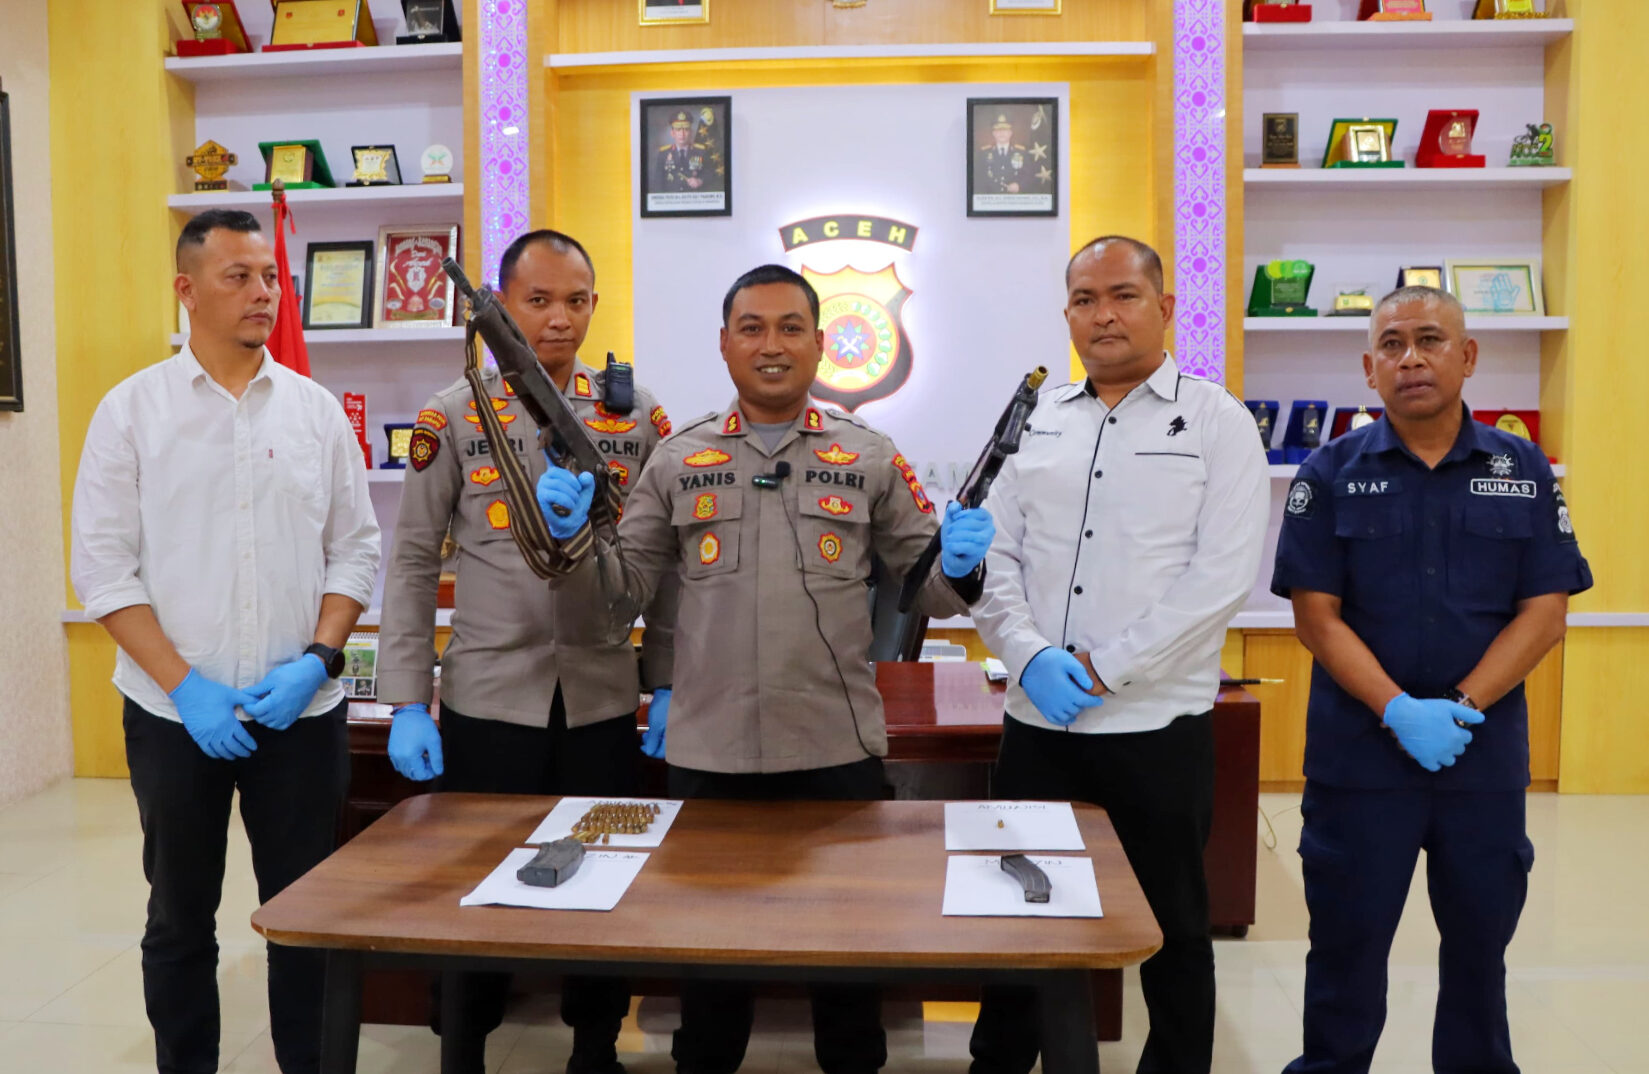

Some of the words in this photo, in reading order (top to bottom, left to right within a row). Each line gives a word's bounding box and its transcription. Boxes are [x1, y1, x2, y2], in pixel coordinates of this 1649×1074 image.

[792, 220, 906, 244] ACEH
[466, 438, 523, 456] JERI
[599, 440, 638, 456] OLRI
[680, 472, 736, 490] YANIS
[806, 470, 865, 489] POLRI
[1347, 482, 1388, 493] SYAF
[1478, 482, 1530, 493] HUMAS
